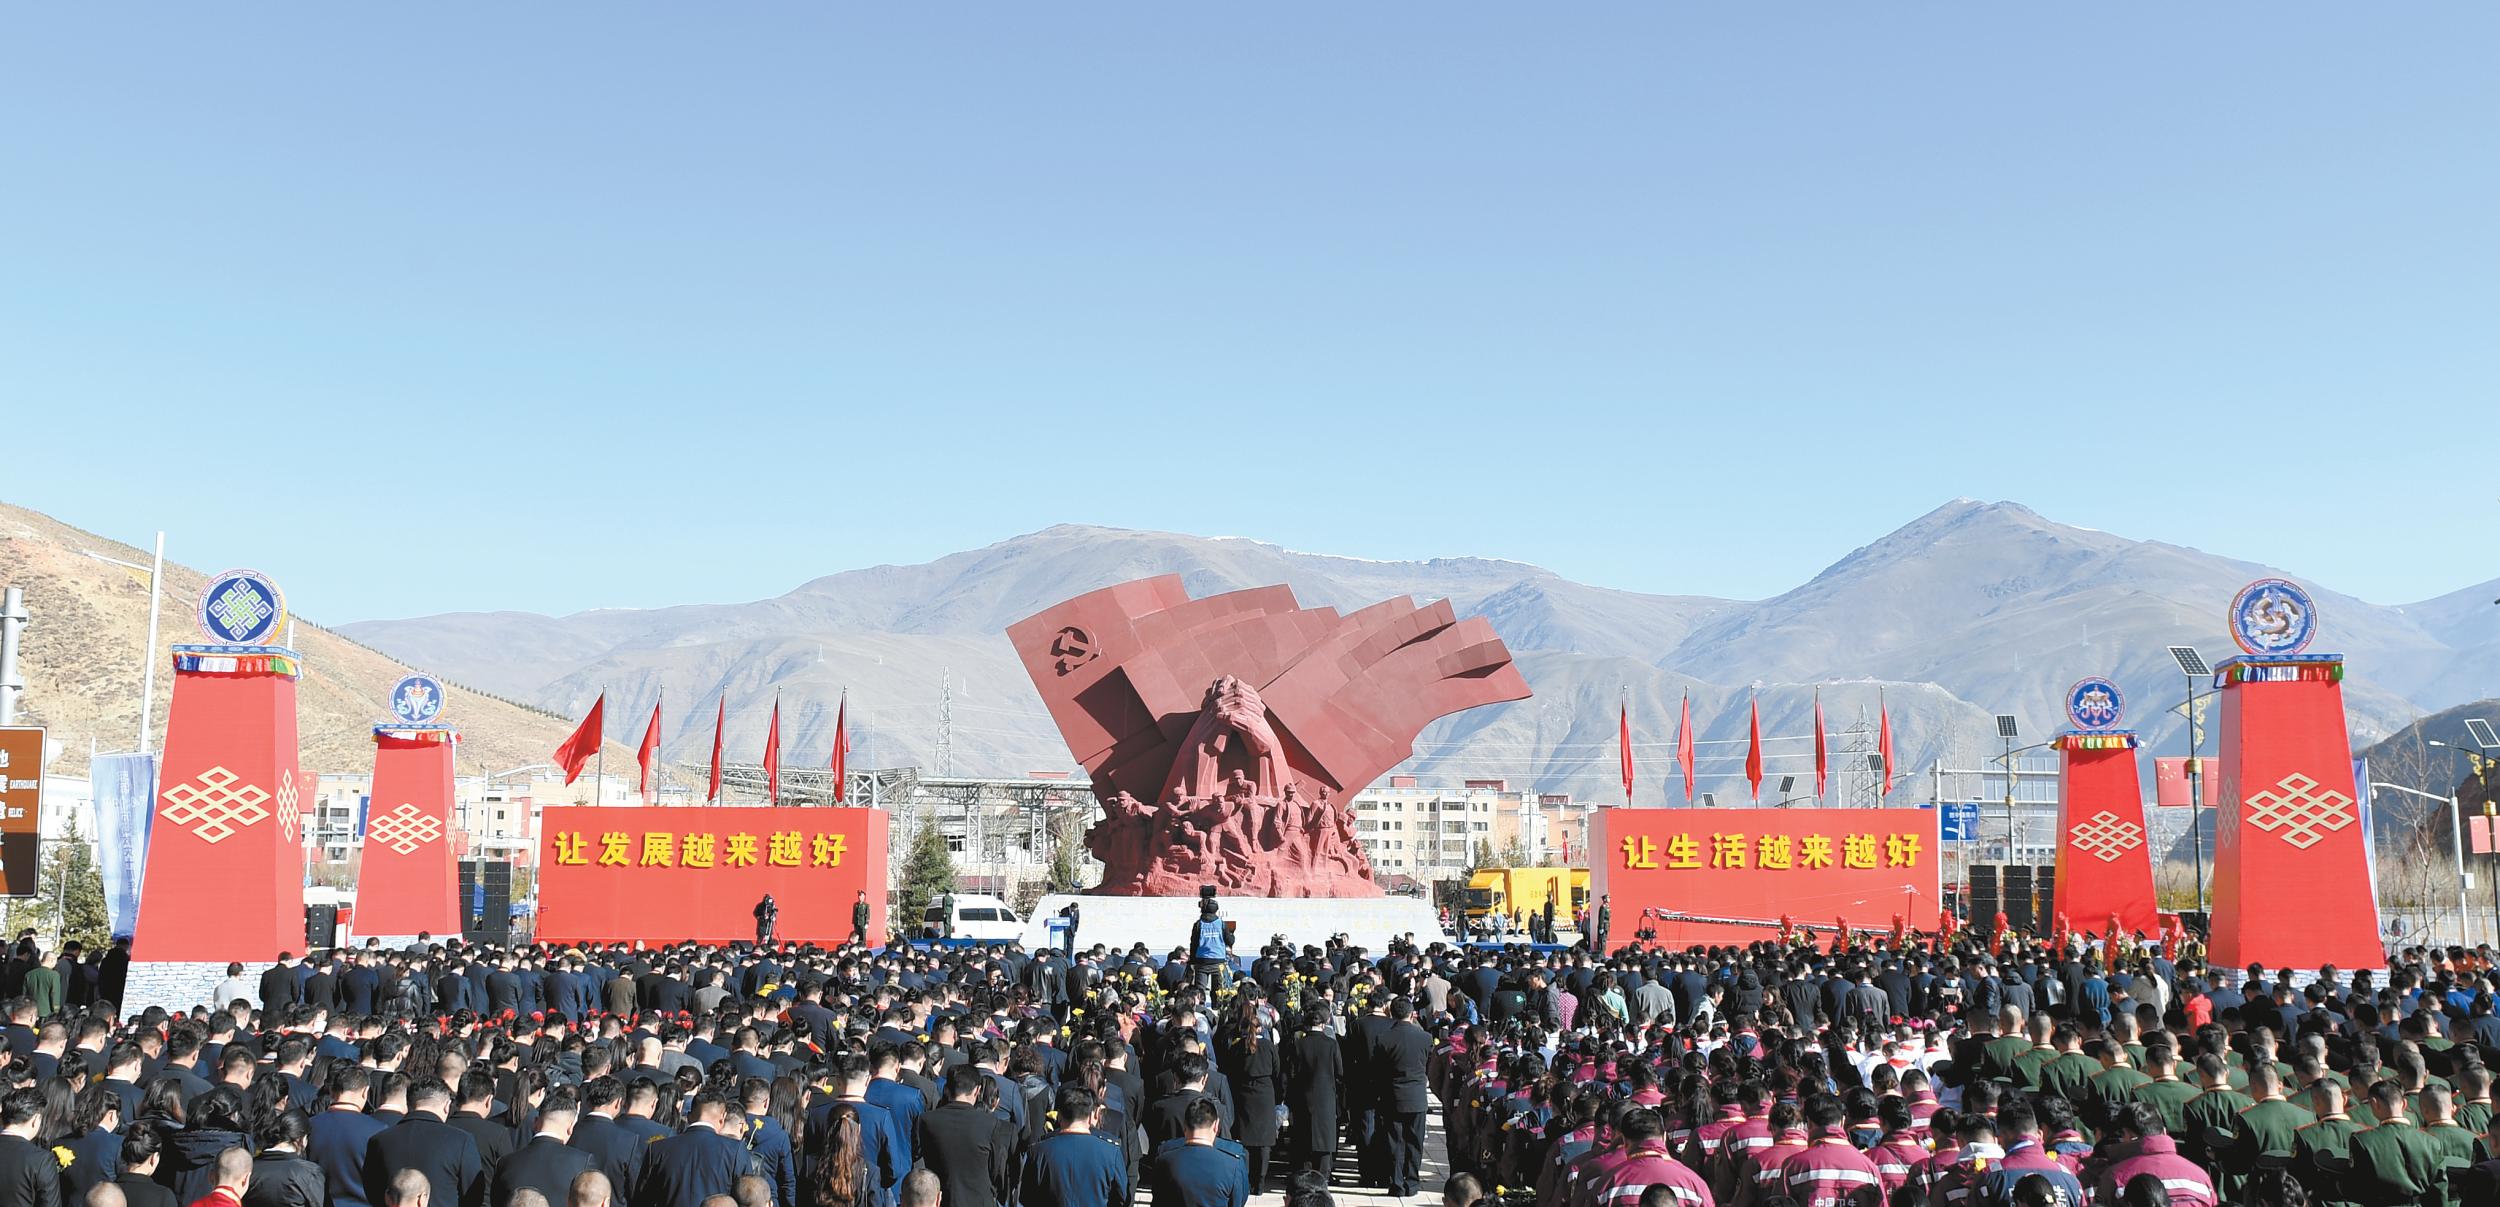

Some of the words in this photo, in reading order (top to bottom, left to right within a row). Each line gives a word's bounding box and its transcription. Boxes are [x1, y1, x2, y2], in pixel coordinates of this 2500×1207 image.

[555, 831, 847, 867] 让发展越来越好
[1623, 832, 1922, 868] 让生活越来越好
